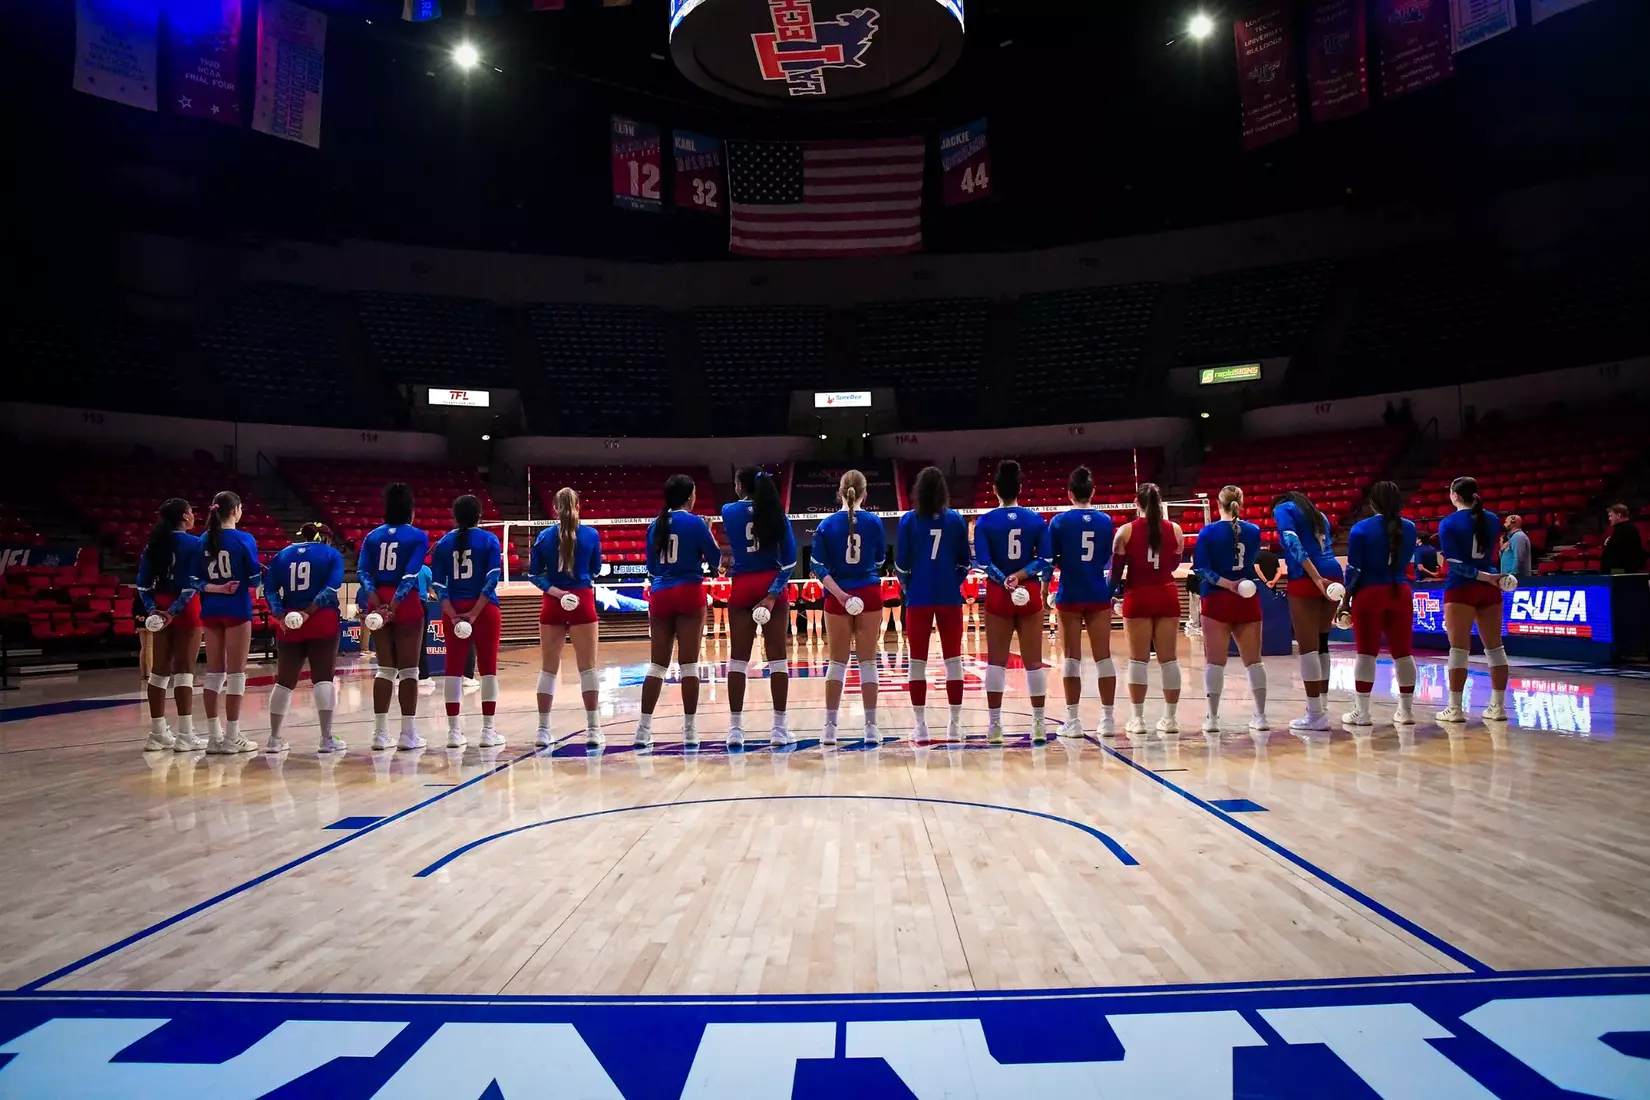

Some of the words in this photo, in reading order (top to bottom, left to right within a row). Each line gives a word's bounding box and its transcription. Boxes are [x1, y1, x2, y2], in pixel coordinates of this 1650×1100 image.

[1244, 28, 1282, 48] UNIVERSITY
[1246, 37, 1282, 57] BULLDOGS
[185, 74, 209, 86] FINAL
[212, 79, 237, 92] FOUR
[196, 66, 223, 79] NCAA
[674, 136, 697, 153] KARL
[940, 130, 971, 151] JACKIE
[626, 159, 662, 200] 12
[692, 177, 717, 208] 32
[960, 162, 989, 194] 44
[450, 391, 469, 401] TFL
[83, 412, 104, 425] 113
[378, 541, 399, 571] 16
[845, 533, 862, 565] 8
[929, 528, 942, 560] 7
[1007, 528, 1022, 560] 6
[1080, 531, 1095, 562] 5
[1147, 546, 1160, 570] 4
[1232, 542, 1246, 571] 3
[289, 561, 311, 592] 19
